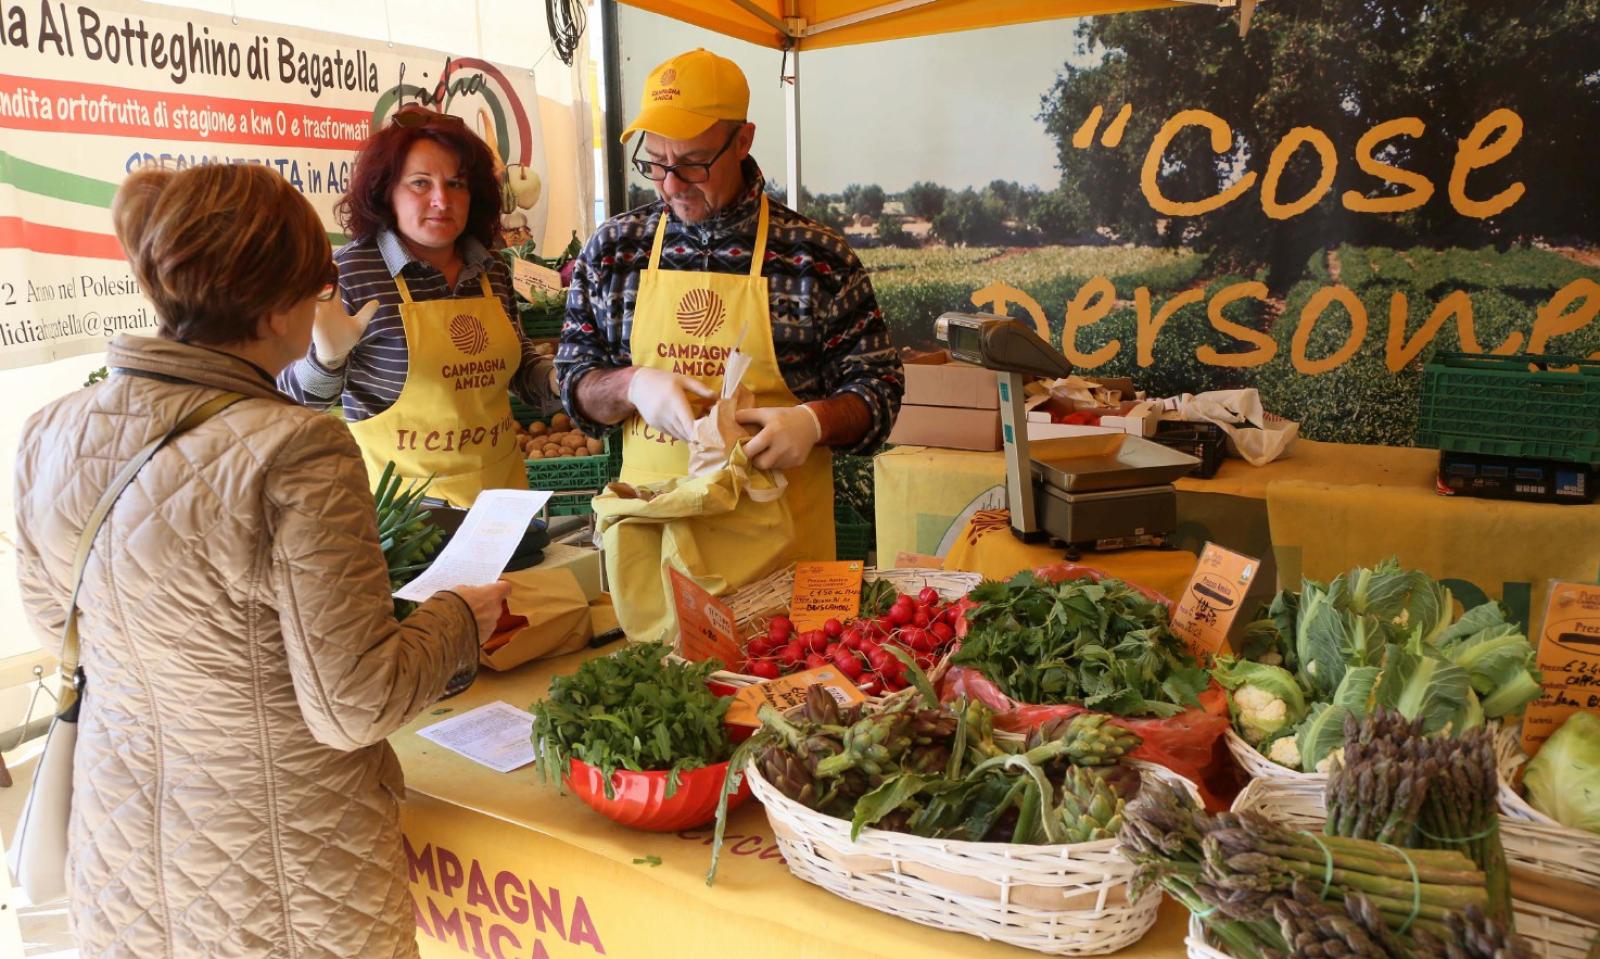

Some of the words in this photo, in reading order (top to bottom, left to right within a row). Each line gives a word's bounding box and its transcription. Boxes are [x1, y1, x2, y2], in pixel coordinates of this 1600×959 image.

[38, 0, 74, 57] Al
[77, 6, 240, 84] Botteghino
[247, 35, 270, 81] di
[277, 37, 379, 98] Bagatella
[57, 94, 150, 127] ortofrutta
[154, 101, 169, 128] di
[173, 103, 237, 138] stagione
[240, 112, 248, 134] a
[251, 109, 273, 135] km
[291, 119, 300, 136] e
[303, 115, 369, 141] trasformati
[307, 161, 322, 194] in
[1, 282, 17, 306] 2
[58, 276, 77, 300] nel
[441, 358, 506, 379] CAMPAGNA
[672, 360, 726, 377] AMICA
[455, 374, 496, 392] AMICA
[424, 426, 487, 453] CIBO
